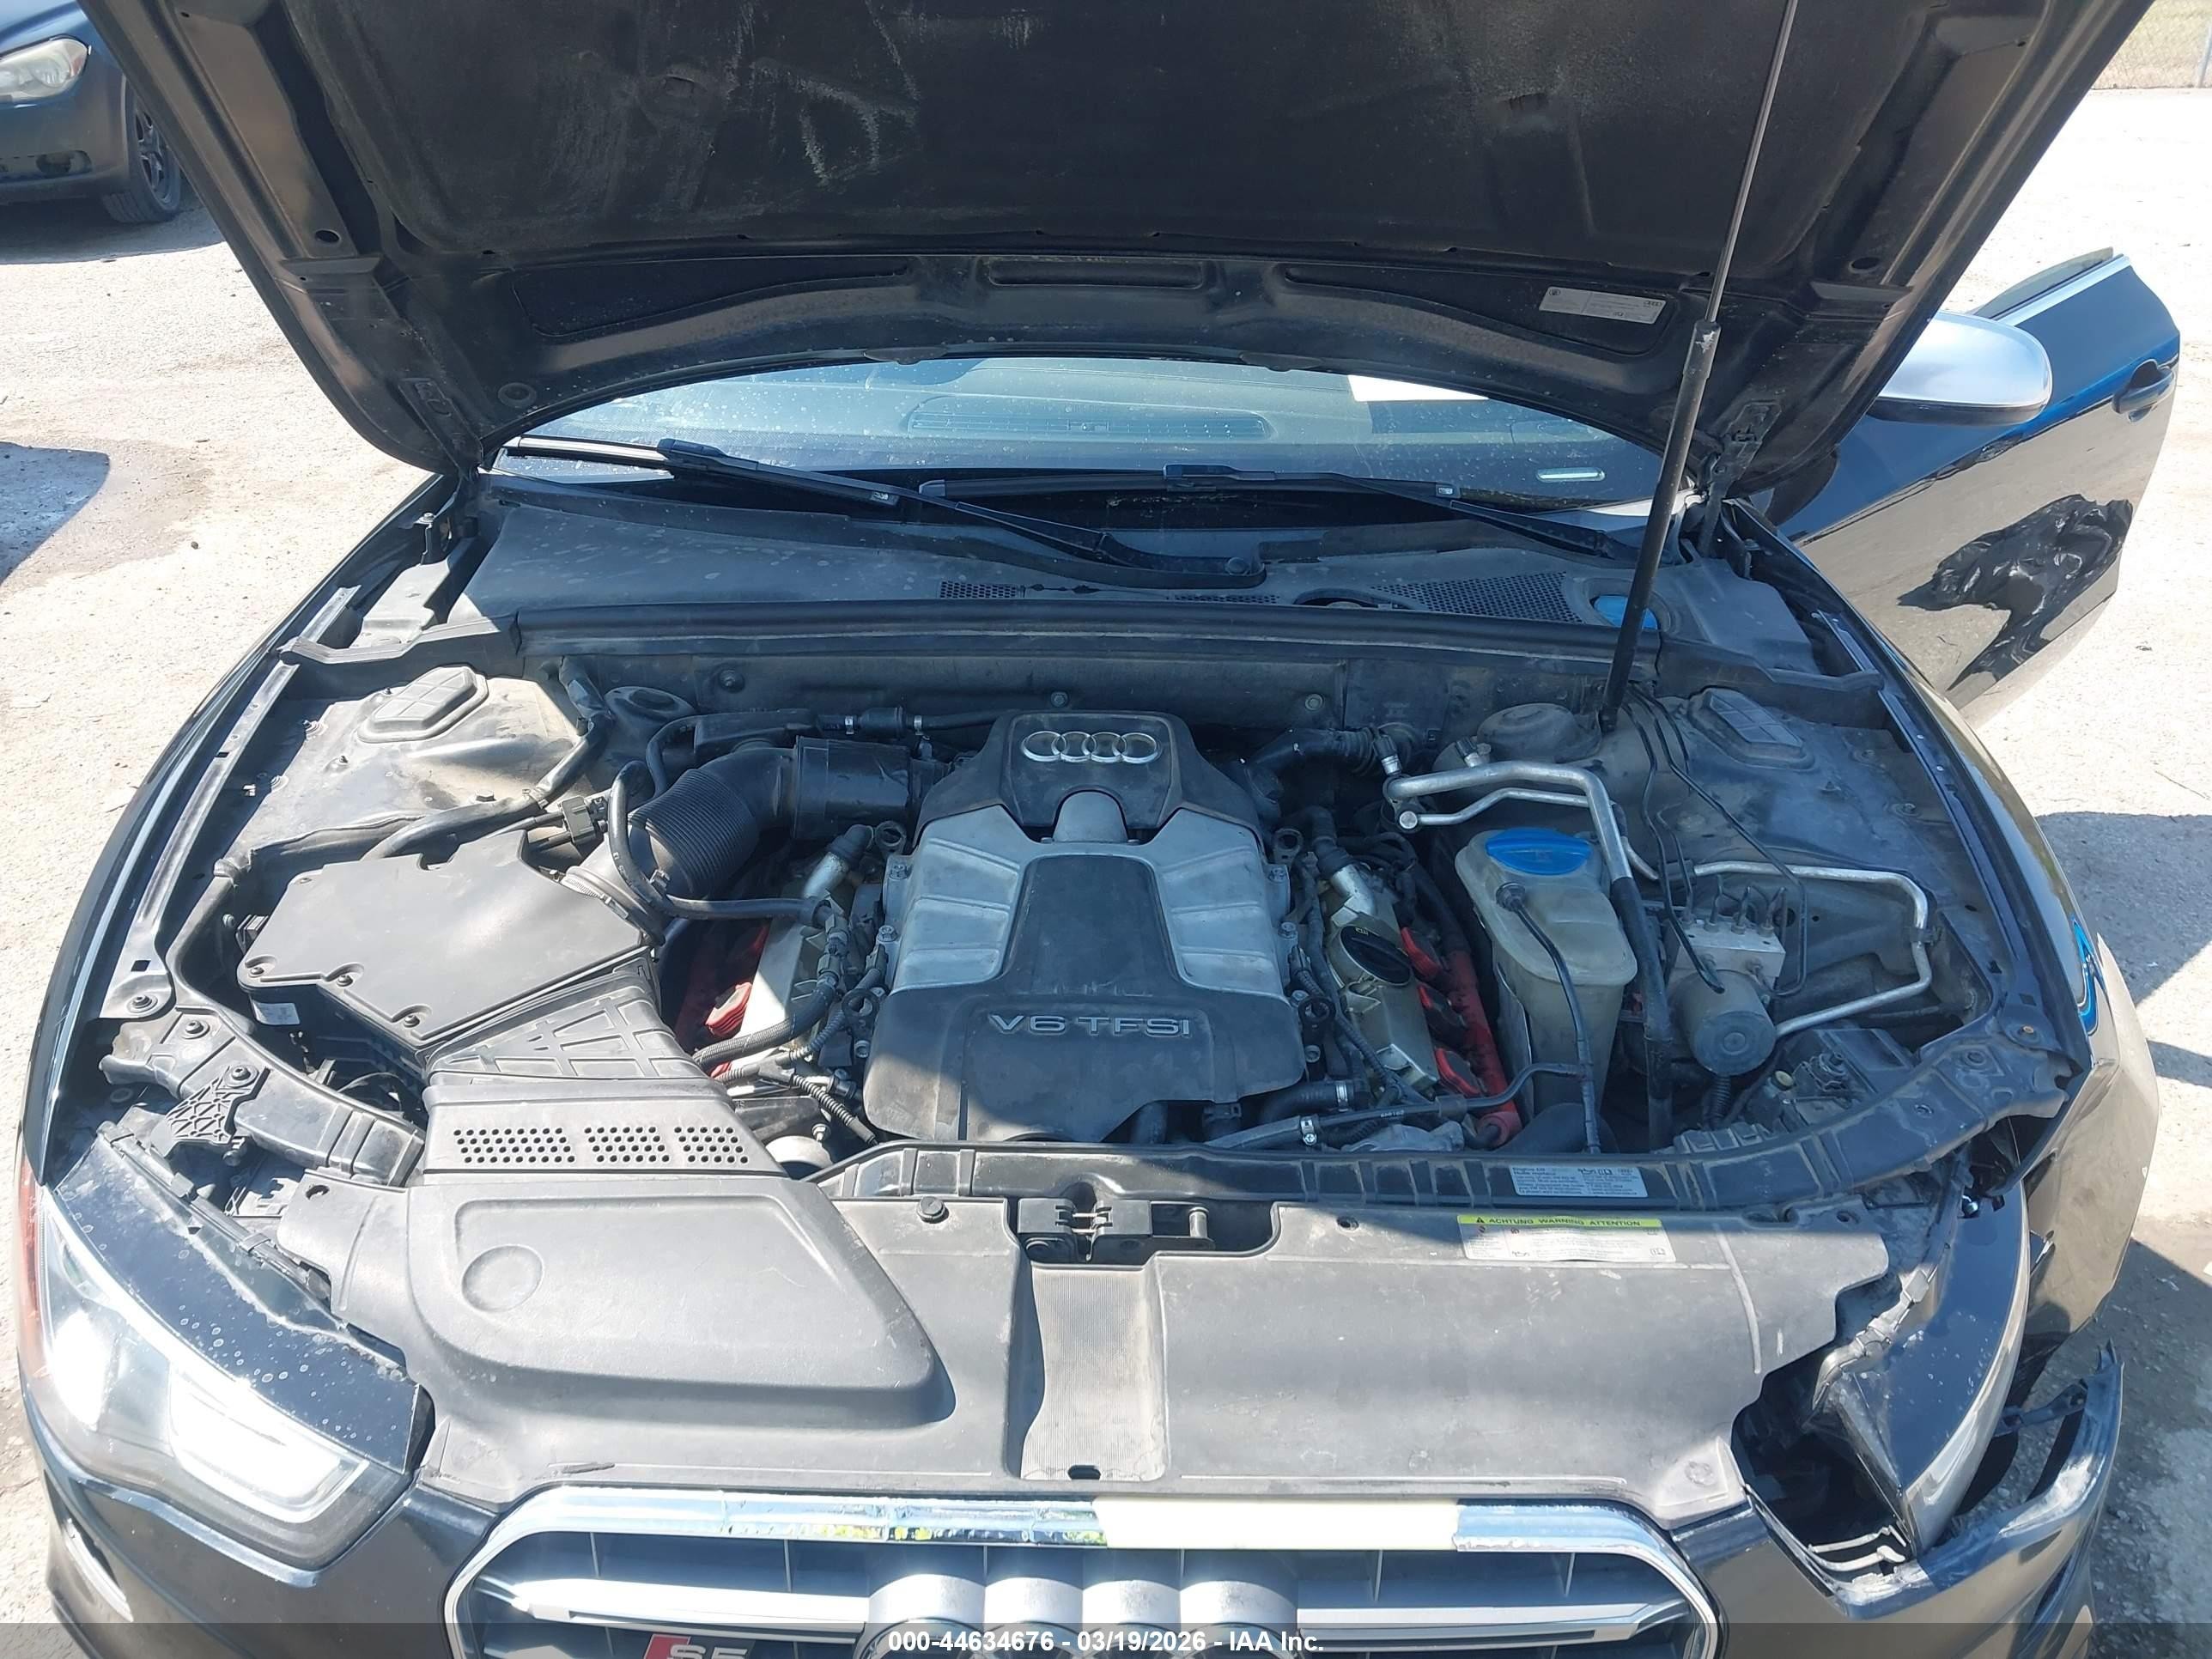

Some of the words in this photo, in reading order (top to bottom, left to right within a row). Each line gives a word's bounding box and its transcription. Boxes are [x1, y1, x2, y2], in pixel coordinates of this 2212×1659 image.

[990, 1014, 1066, 1032] V6
[1078, 1016, 1190, 1036] TFSI
[1538, 1218, 1585, 1226] WARNING
[1589, 1218, 1641, 1227] ATTENTION
